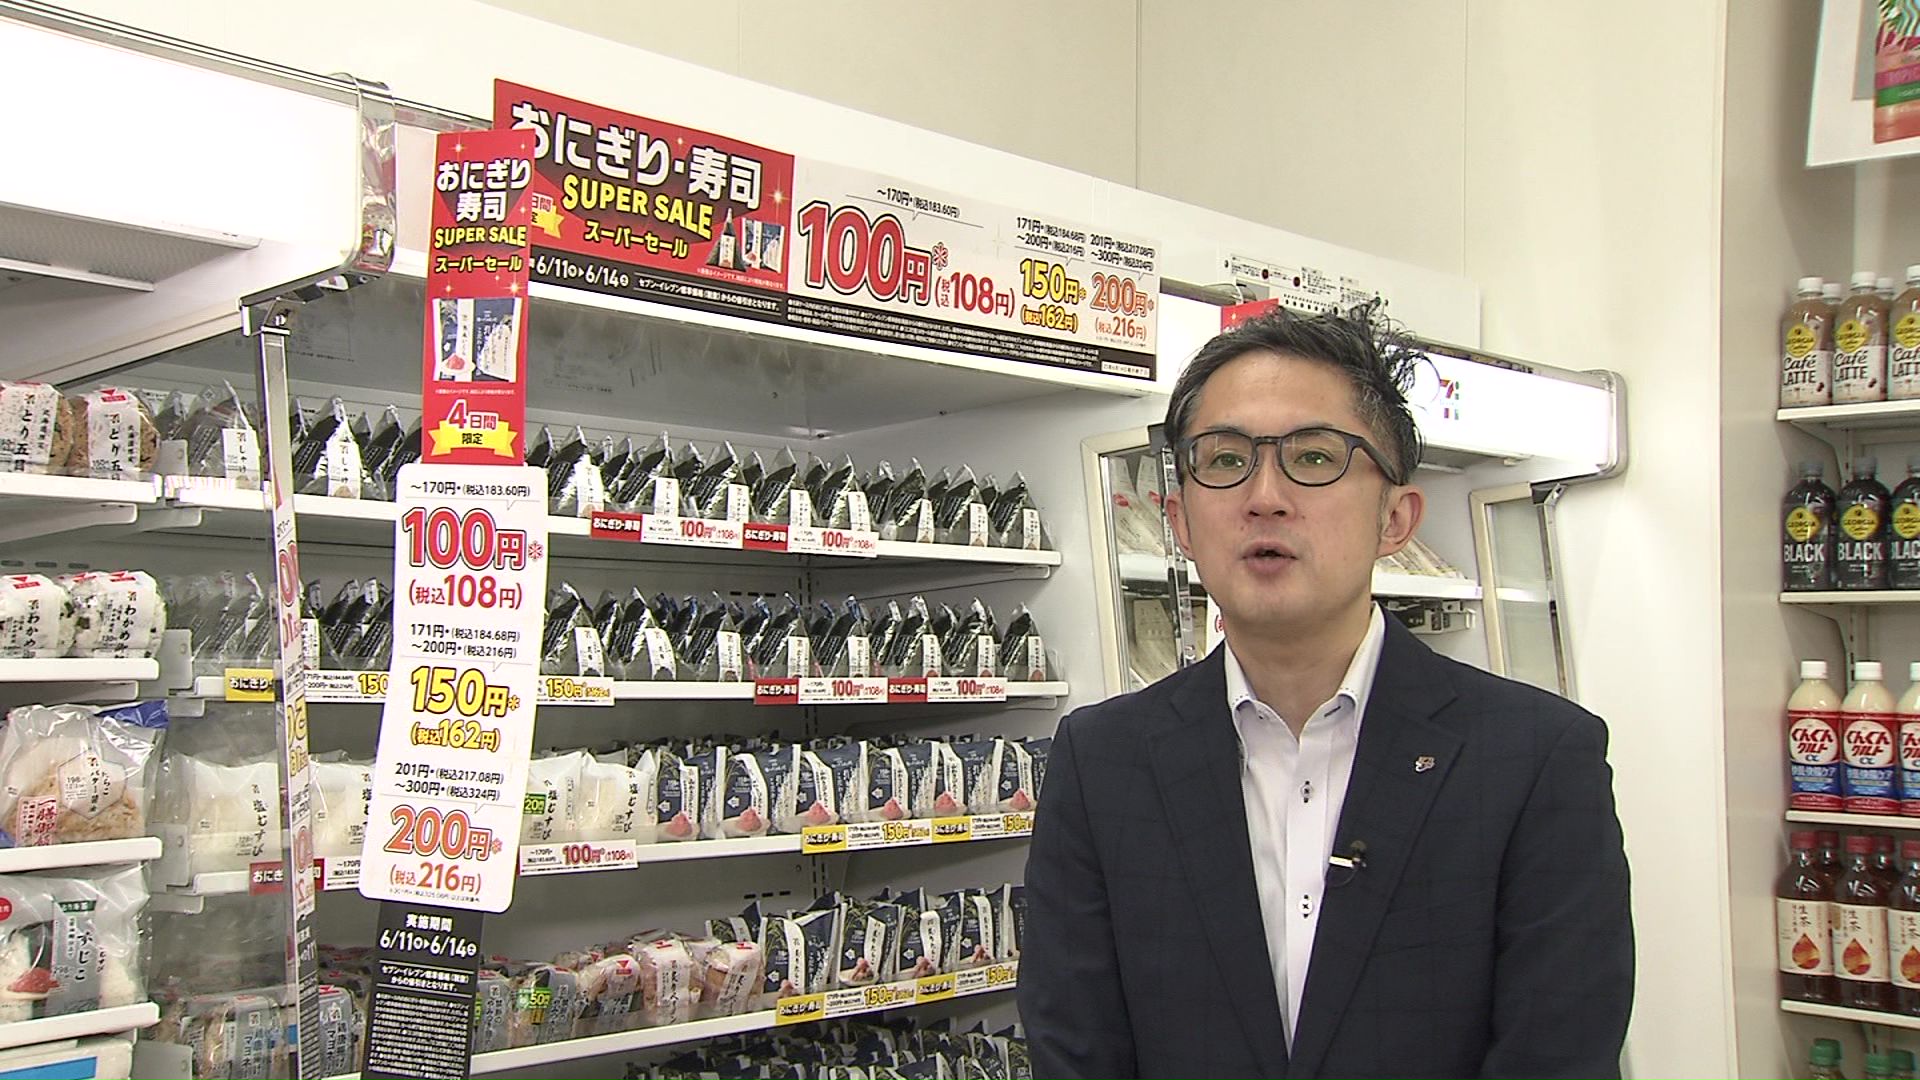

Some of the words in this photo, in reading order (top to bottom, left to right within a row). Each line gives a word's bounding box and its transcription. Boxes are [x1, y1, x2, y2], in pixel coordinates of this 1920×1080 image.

[436, 158, 533, 191] おにぎり
[455, 191, 508, 223] 寿司
[562, 173, 649, 218] SUPER
[654, 194, 715, 241] SALE
[434, 226, 485, 250] SUPER
[489, 226, 528, 248] SALE
[584, 220, 689, 260] スーパーセール
[434, 254, 524, 273] スーパーセール
[935, 271, 1015, 319] (税込108円)
[1834, 350, 1868, 368] Café
[1834, 366, 1868, 382] LATTE
[1783, 370, 1817, 386] LATTE
[447, 399, 499, 431] 4日間
[461, 432, 484, 446] 限定
[1784, 543, 1825, 562] BLACK
[1837, 541, 1884, 561] BLACK
[408, 574, 523, 610] (税込108円)
[410, 719, 501, 753] (税込162円)
[389, 861, 482, 896] (税込216円)
